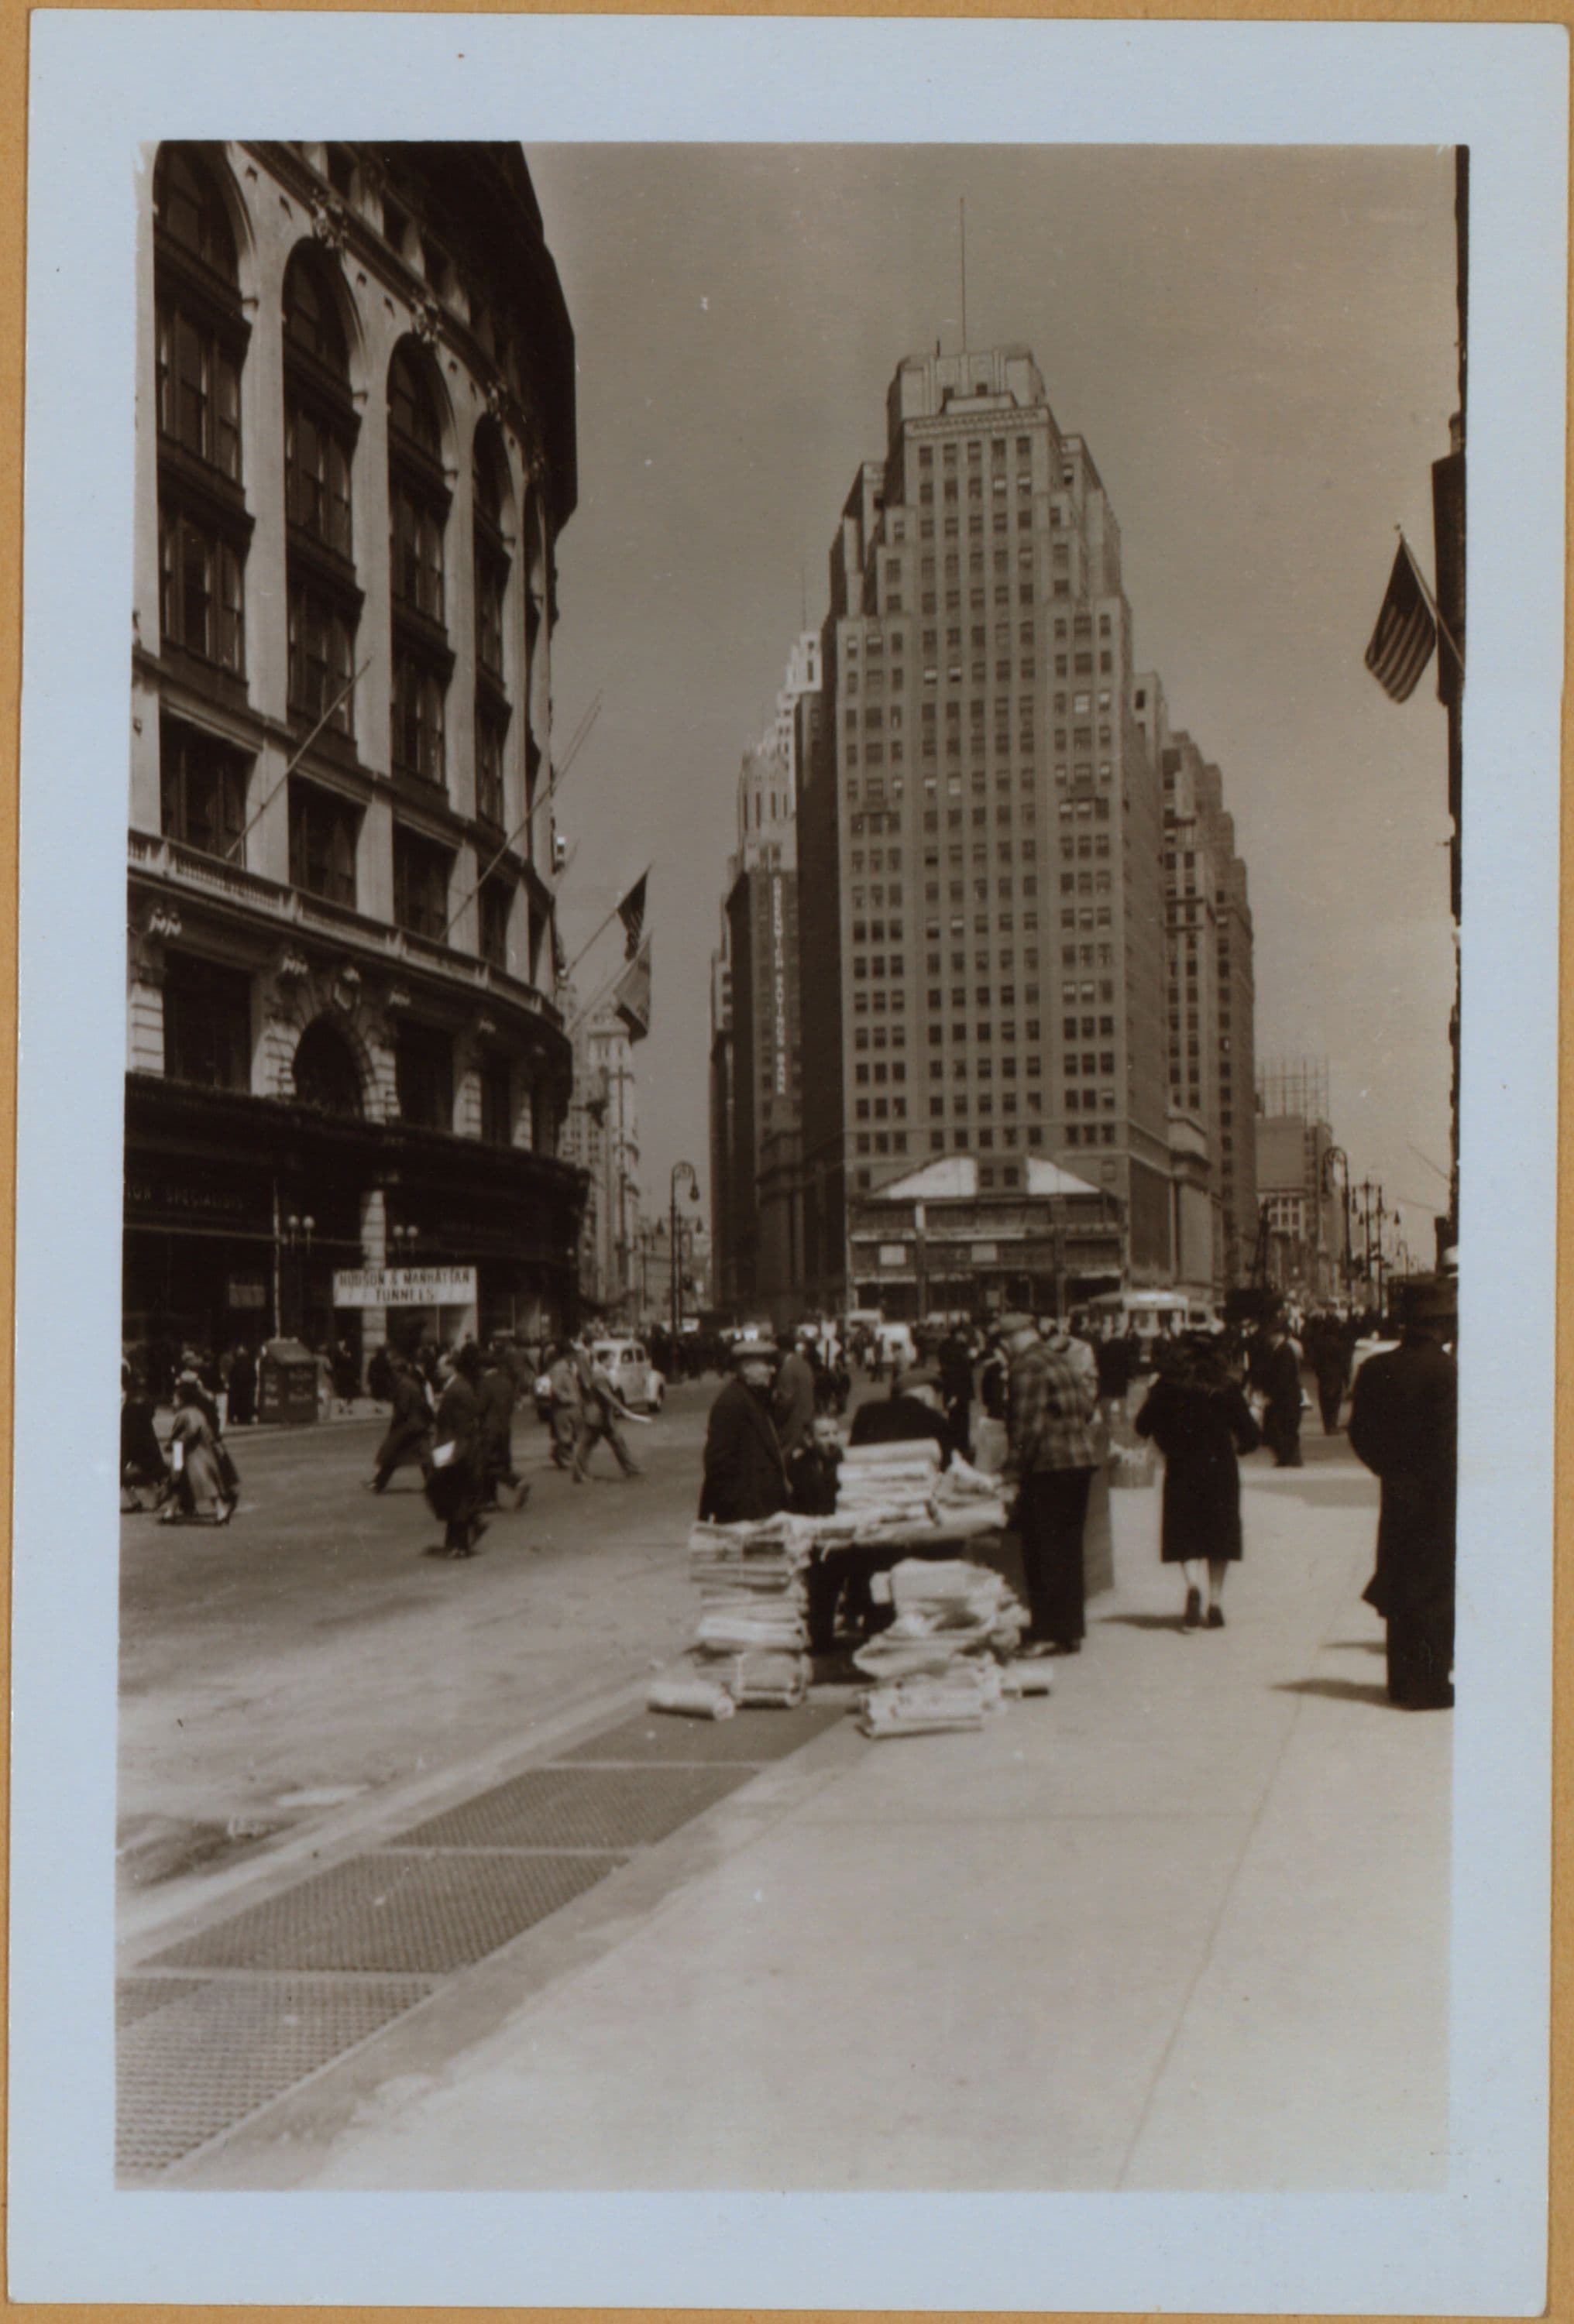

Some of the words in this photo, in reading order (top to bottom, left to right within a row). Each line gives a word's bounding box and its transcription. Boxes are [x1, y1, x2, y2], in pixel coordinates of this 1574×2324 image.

[775, 1051, 786, 1095] BANK
[339, 1271, 385, 1286] HUDSON
[404, 1268, 469, 1285] MANHATTAN
[376, 1288, 435, 1301] TUNNELS
